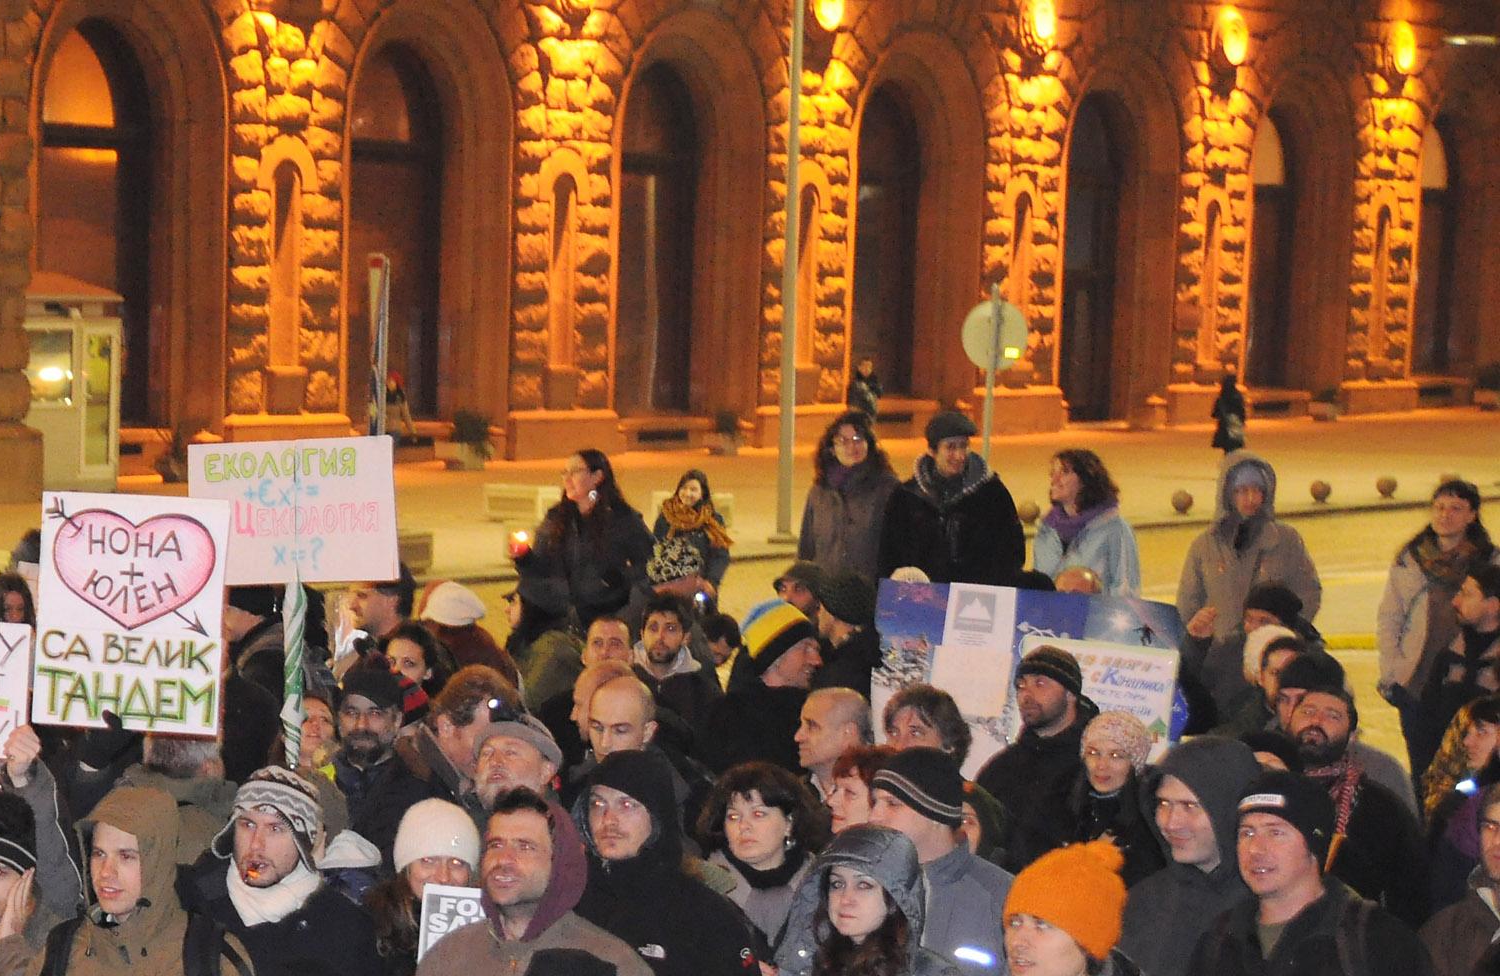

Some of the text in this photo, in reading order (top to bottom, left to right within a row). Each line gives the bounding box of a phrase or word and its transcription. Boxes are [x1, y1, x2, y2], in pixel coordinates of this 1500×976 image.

[204, 447, 357, 483] ЕКОЛОГИЯ
[235, 500, 381, 538] ЦЕКОЛОГИЯ
[88, 523, 183, 562] НОНА
[83, 569, 179, 614] ЮЛЕН
[41, 629, 218, 674] СА ВЕЛИК
[36, 664, 217, 729] ТАНДЕМ
